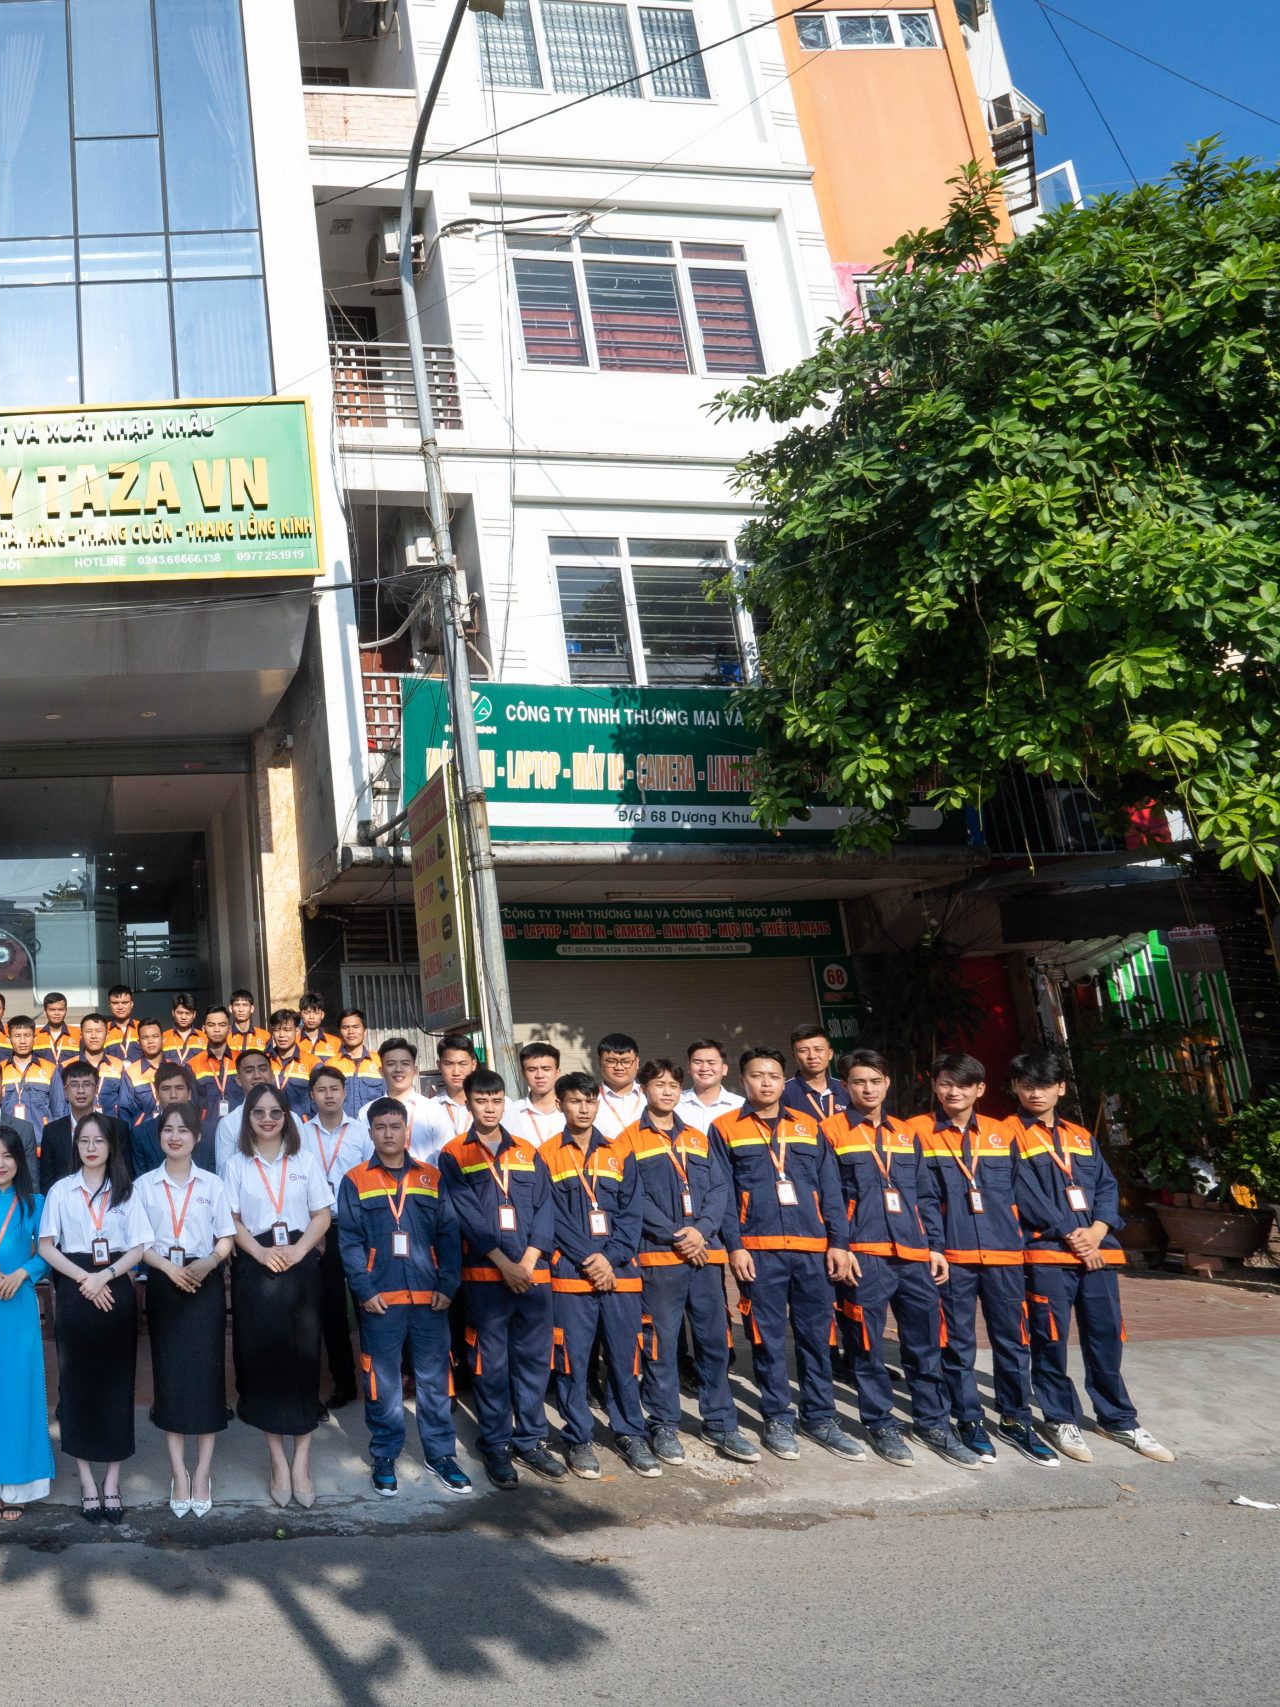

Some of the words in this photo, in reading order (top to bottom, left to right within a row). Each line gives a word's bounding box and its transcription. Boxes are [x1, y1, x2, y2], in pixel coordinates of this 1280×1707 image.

[14, 421, 40, 445] VÀ
[47, 416, 95, 443] XUẤT
[103, 417, 154, 444] NHẬP
[161, 410, 215, 440] KHẨU
[37, 461, 182, 520] TAZA
[192, 456, 270, 513] VN
[26, 524, 66, 549] HÀNG
[77, 525, 127, 548] THANG
[131, 519, 173, 545] CUỐN
[186, 518, 234, 543] THANG
[239, 511, 276, 541] LỒNG
[281, 513, 313, 539] KÍNH
[74, 556, 127, 569] HOTLINE
[505, 701, 551, 723] CÔNG
[554, 707, 574, 723] TY
[578, 707, 620, 724] TNHH
[624, 707, 689, 726] THƯƠNG
[693, 710, 720, 729] MẠI
[723, 703, 744, 726] VÀ
[506, 749, 561, 790] LAPTOP
[572, 744, 607, 790] MÁY
[607, 752, 625, 791] IN
[636, 753, 696, 792] CAMERA
[706, 754, 740, 793] LINH
[650, 810, 667, 823] 68
[671, 808, 717, 827] Dương
[504, 906, 536, 919] CÔNG
[539, 909, 552, 919] TY
[555, 909, 585, 919] TNHH
[587, 908, 631, 920] THƯƠNG
[633, 909, 654, 921] MẠI
[655, 906, 670, 919] VÀ
[672, 904, 703, 919] CÔNG
[737, 907, 768, 920] NGỌC
[770, 906, 792, 917] ANH
[522, 923, 562, 940] LAPTOP
[569, 921, 593, 940] MÁY
[593, 923, 607, 939] IN
[613, 923, 656, 939] CAMERA
[662, 923, 687, 939] LINH
[686, 920, 712, 941] KIỆN
[718, 921, 741, 941] MỰC
[741, 922, 755, 938] IN
[761, 916, 788, 937] THIẾT
[800, 920, 832, 939] MẠNG
[826, 968, 845, 985] 68
